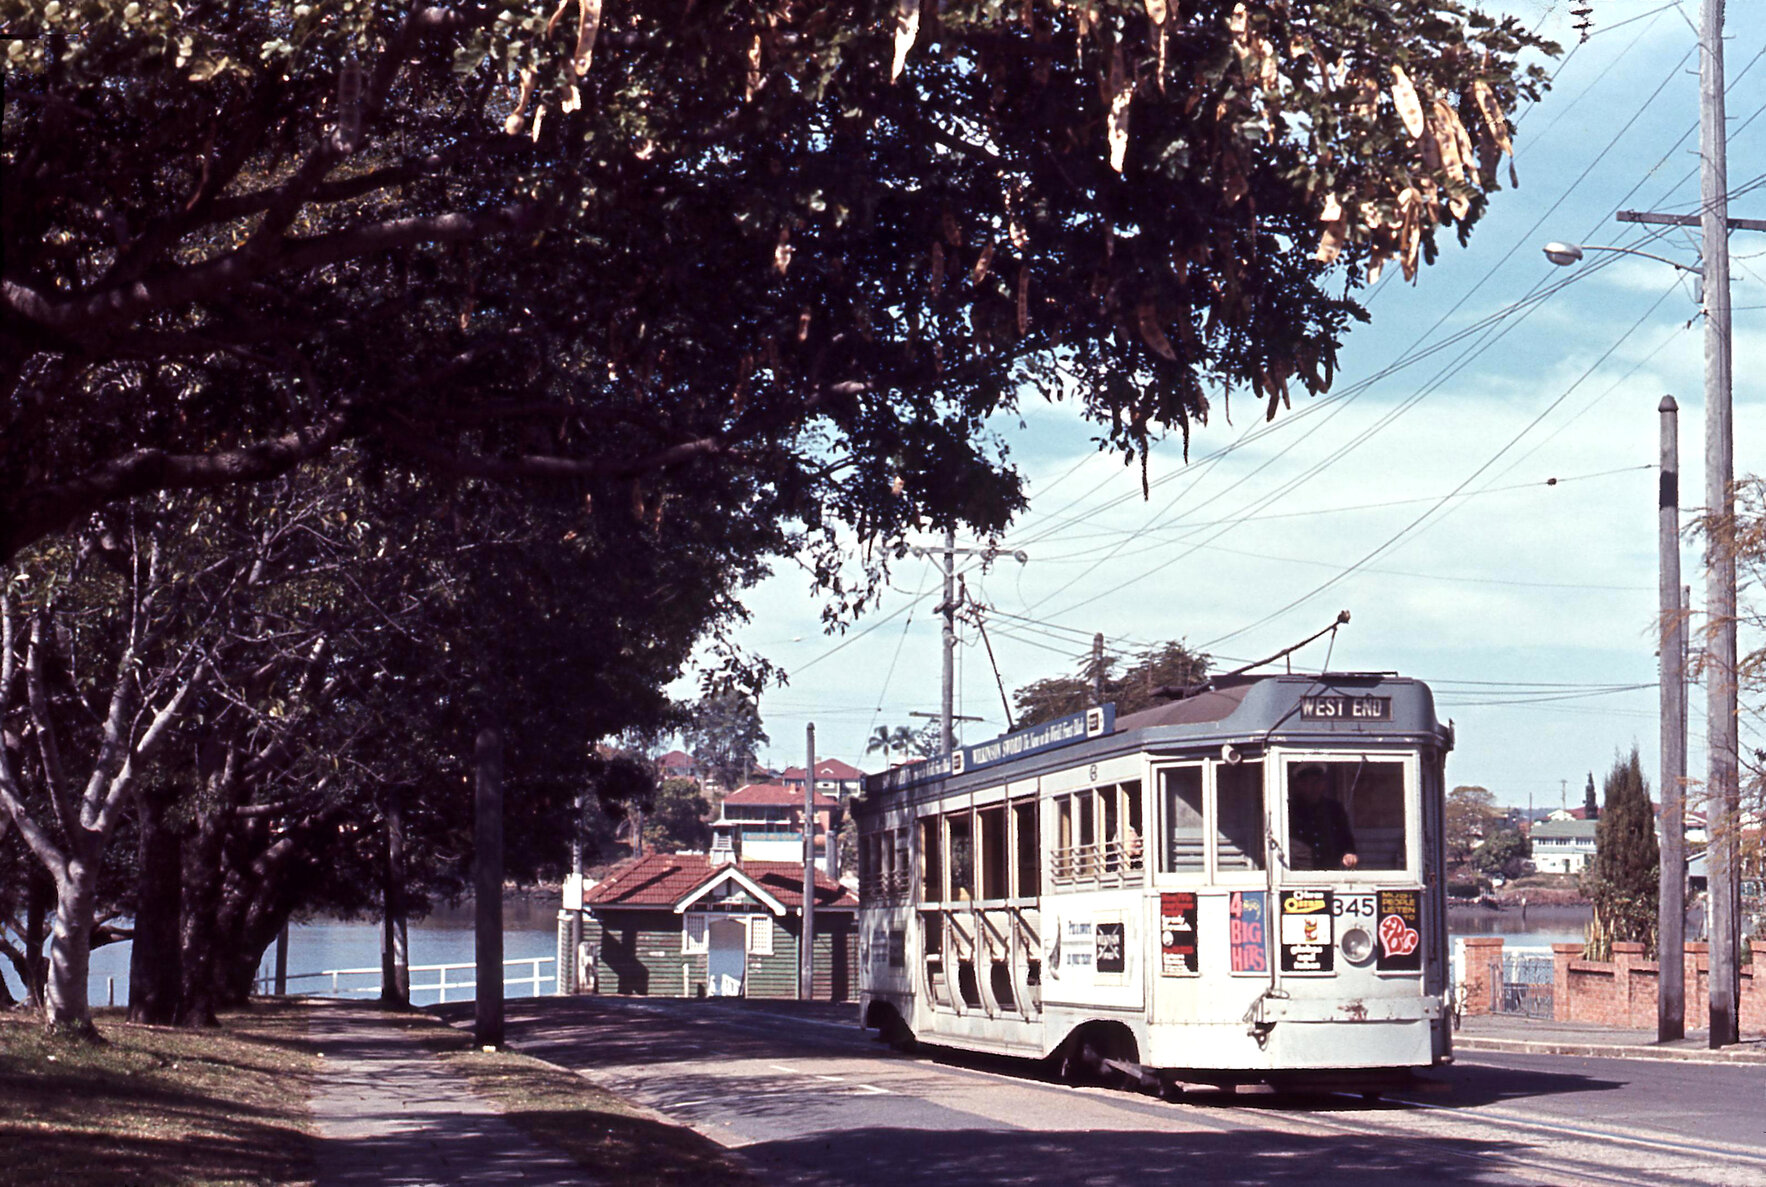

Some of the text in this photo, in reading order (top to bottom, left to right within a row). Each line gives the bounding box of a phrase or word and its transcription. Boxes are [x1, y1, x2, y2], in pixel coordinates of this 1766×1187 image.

[1302, 698, 1382, 717] WEST END
[1230, 892, 1243, 917] 4
[1333, 898, 1374, 917] 345
[1382, 906, 1415, 914] LISTEN
[1230, 919, 1262, 945] BIG
[1231, 945, 1266, 972] HITS
